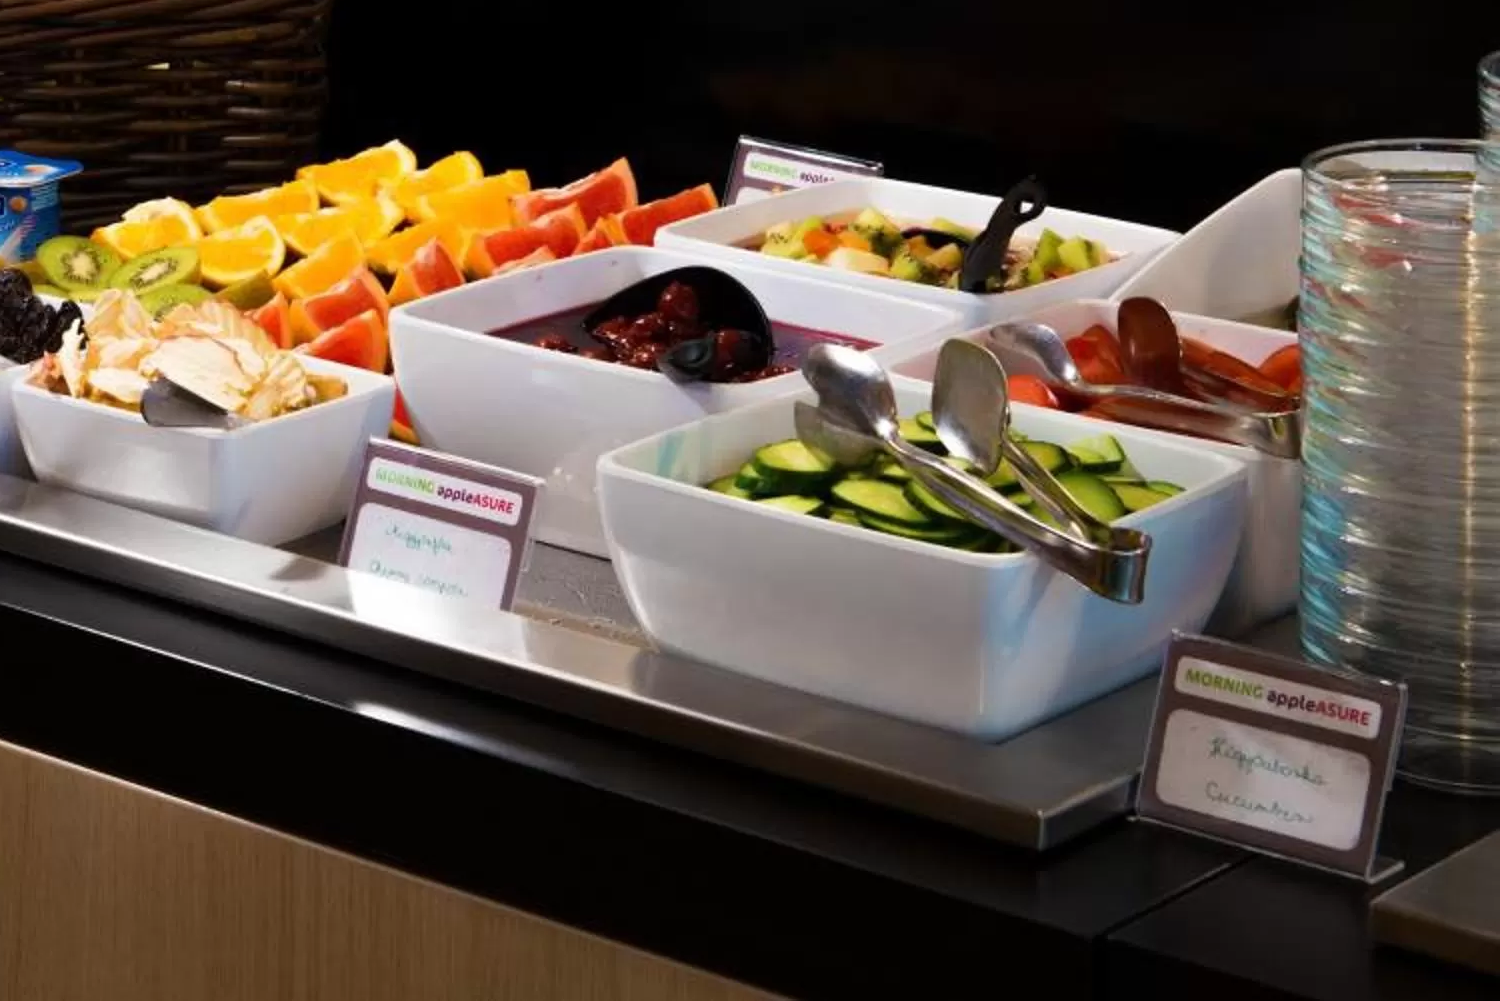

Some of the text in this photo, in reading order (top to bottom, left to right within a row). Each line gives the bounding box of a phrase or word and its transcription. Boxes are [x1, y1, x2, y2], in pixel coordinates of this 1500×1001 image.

[436, 485, 515, 515] appleASURE
[1185, 667, 1371, 727] MORNING appleASURE
